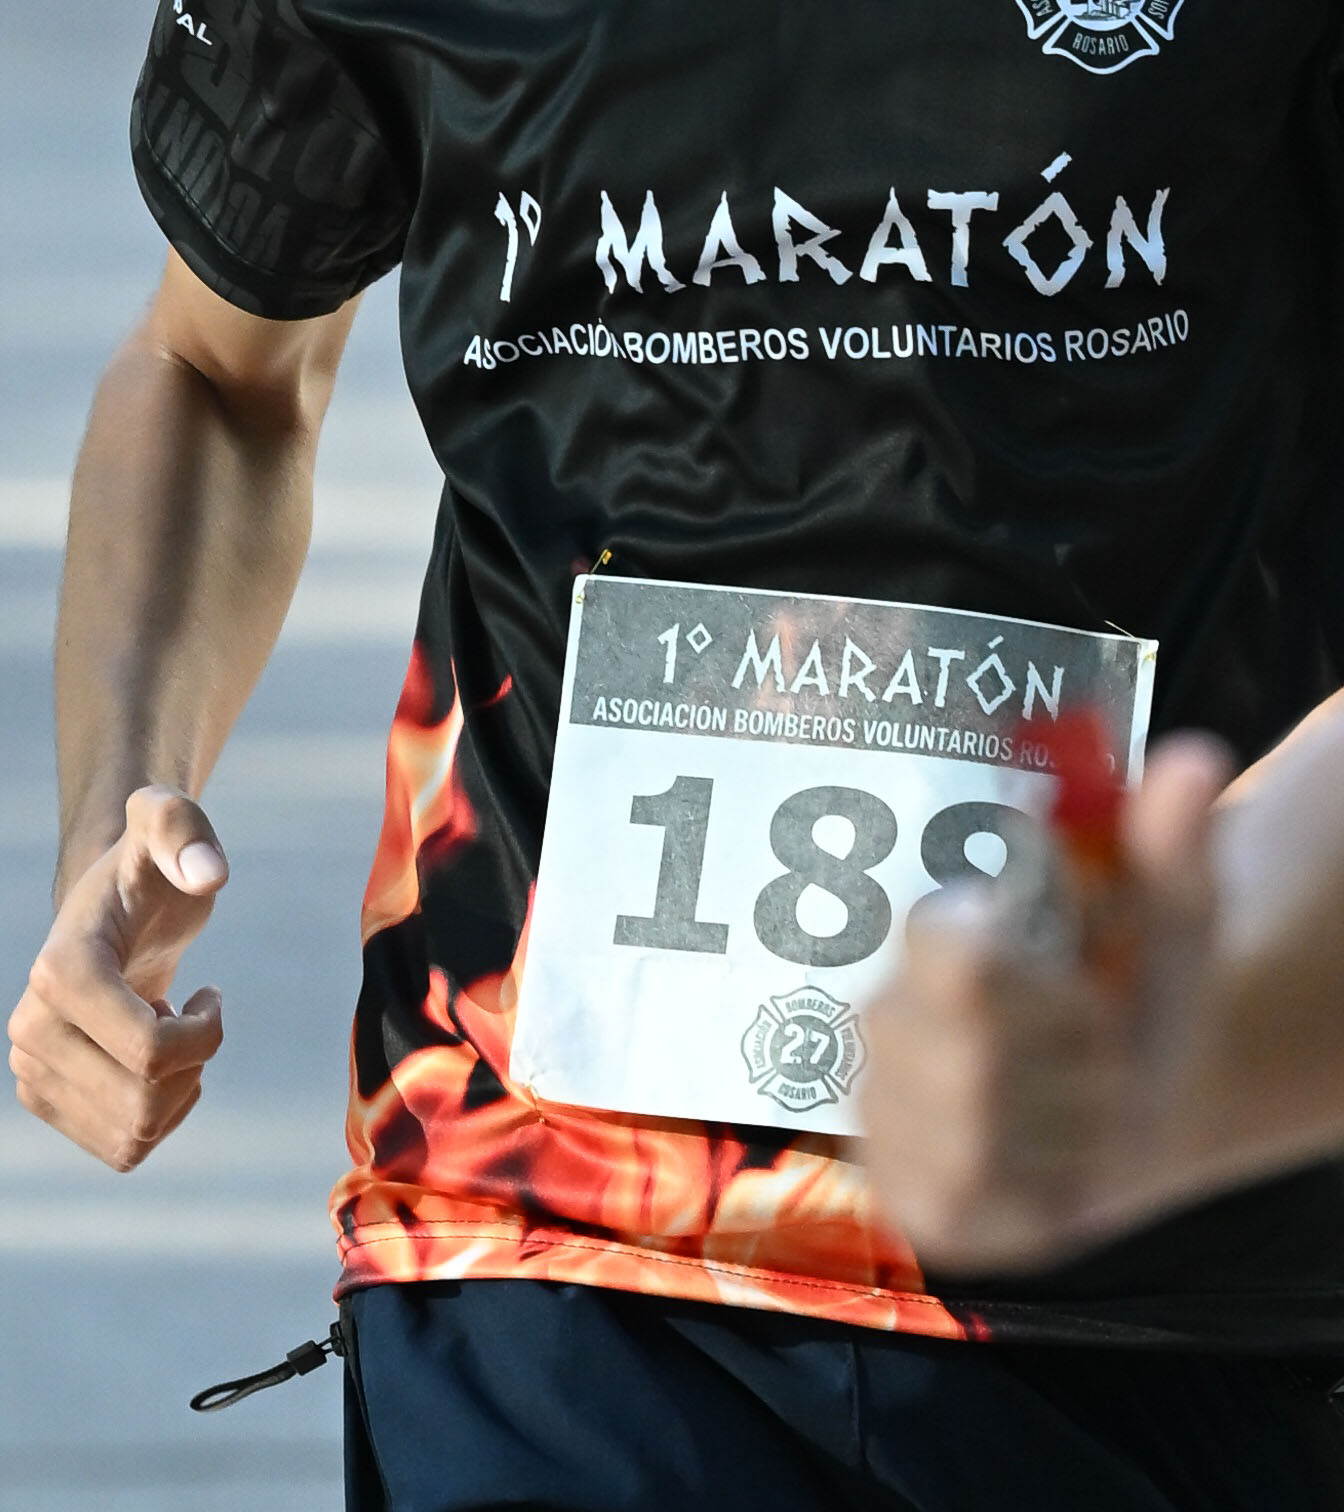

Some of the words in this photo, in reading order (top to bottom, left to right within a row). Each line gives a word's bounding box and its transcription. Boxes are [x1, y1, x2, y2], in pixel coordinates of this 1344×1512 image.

[1072, 32, 1129, 56] ROSARIO
[595, 151, 1170, 297] MARATÓN
[623, 327, 809, 365] BOMBEROS
[819, 323, 1056, 364] VOLUNTARIOS
[1064, 309, 1190, 362] ROSARIO
[731, 627, 1065, 723] MARATÓN
[593, 696, 727, 732] ASOCIACIÓN
[734, 708, 855, 743] BOMBEROS
[863, 720, 1014, 762] VOLUNTARIOS
[780, 1023, 830, 1064] 27
